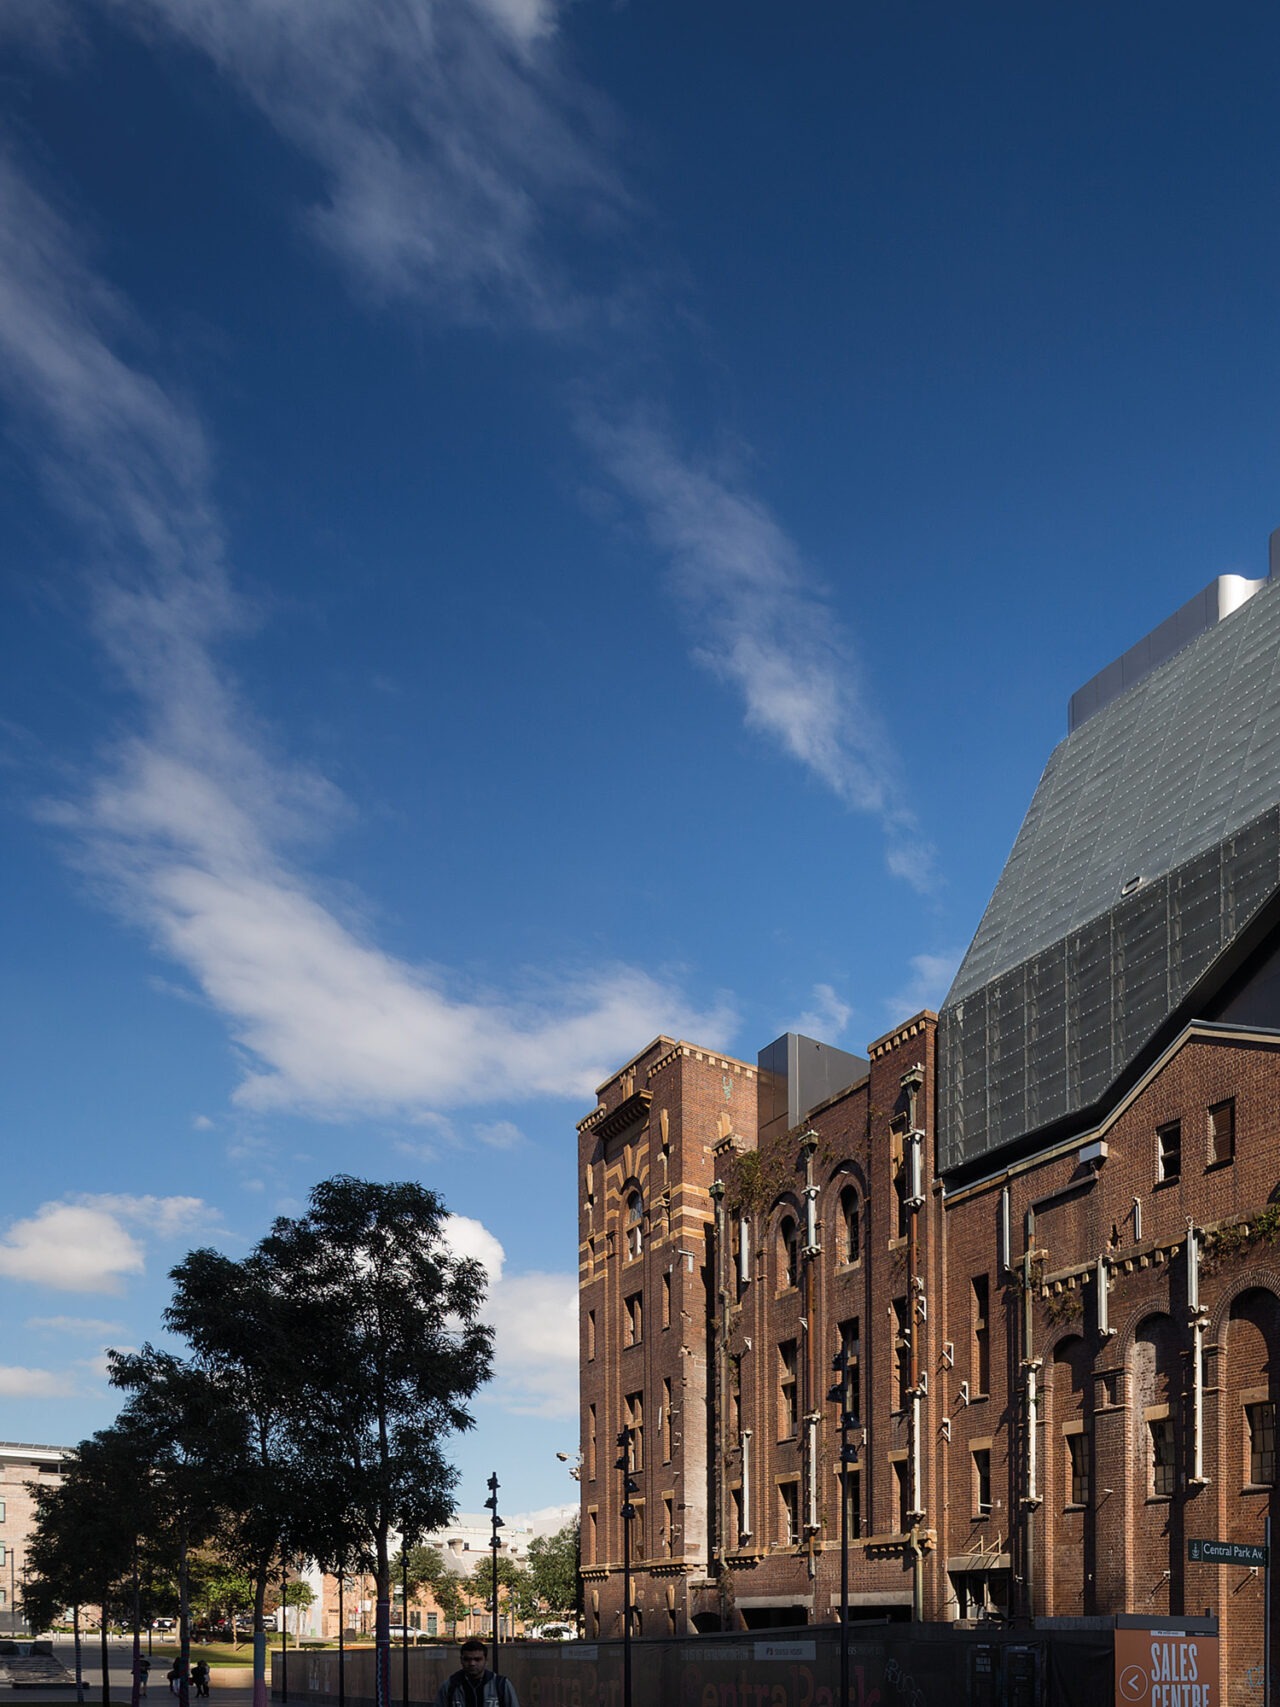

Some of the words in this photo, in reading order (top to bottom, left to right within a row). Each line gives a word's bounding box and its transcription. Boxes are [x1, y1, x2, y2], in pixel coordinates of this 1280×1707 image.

[1203, 1543, 1232, 1556] Central
[1234, 1546, 1250, 1558] Park
[1151, 1642, 1198, 1682] SALES
[1151, 1684, 1210, 1707] CENTRE
